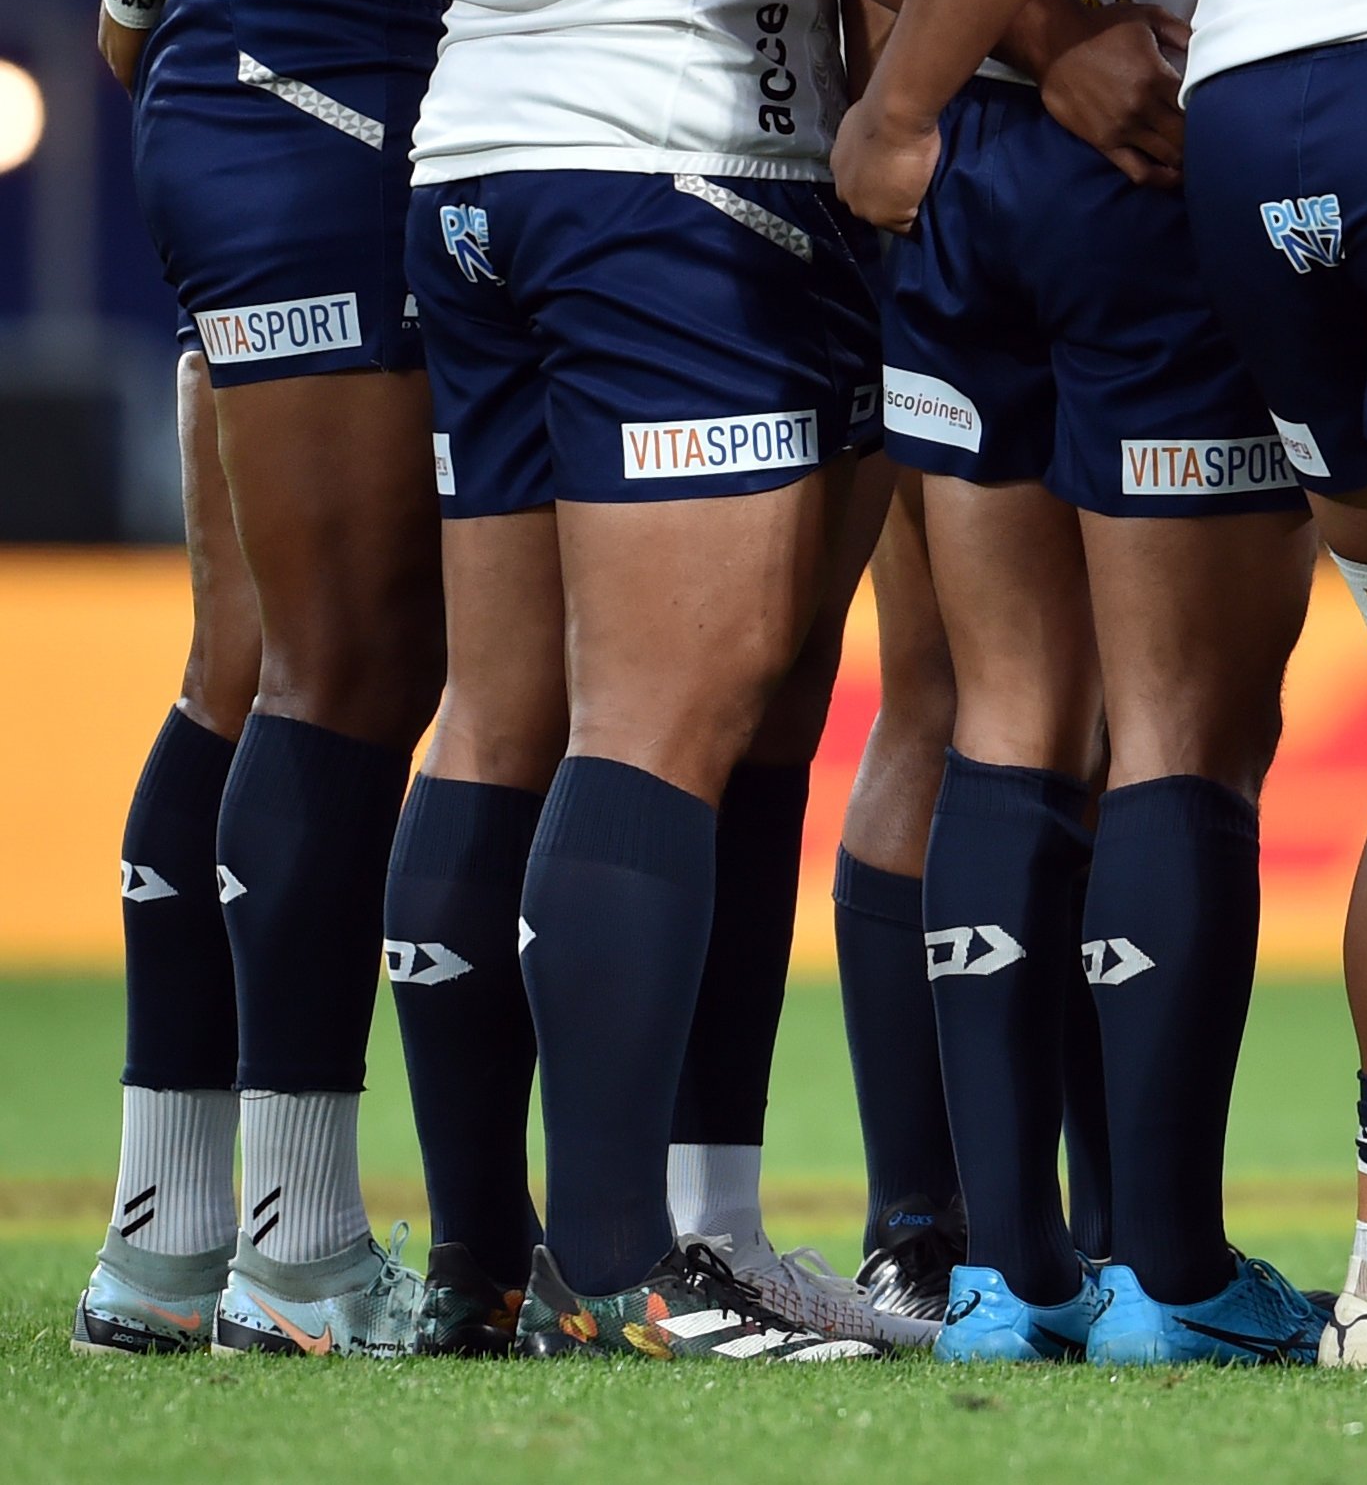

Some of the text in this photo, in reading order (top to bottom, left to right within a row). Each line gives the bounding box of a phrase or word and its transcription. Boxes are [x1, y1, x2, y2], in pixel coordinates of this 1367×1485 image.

[199, 300, 351, 358] VITASPORT
[885, 385, 973, 431] iscojoinery
[628, 416, 813, 470] VITASPORT
[1128, 443, 1290, 489] VITASPOR
